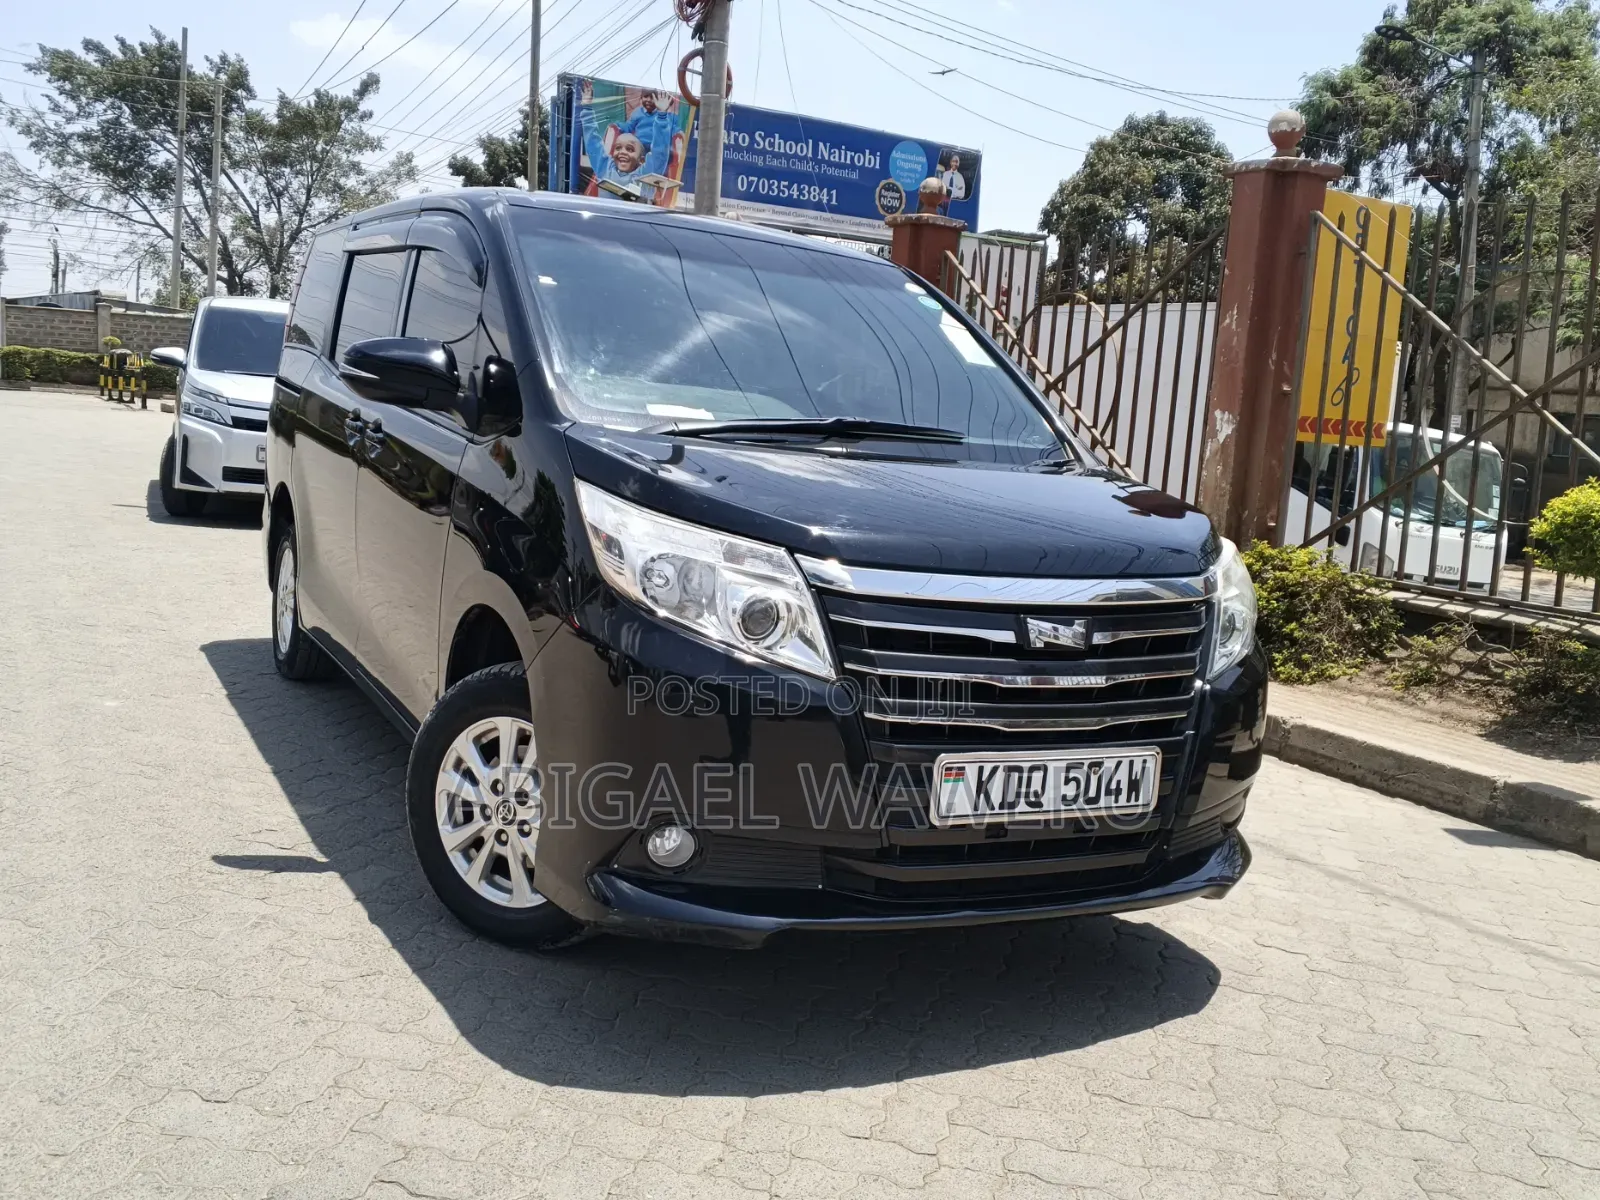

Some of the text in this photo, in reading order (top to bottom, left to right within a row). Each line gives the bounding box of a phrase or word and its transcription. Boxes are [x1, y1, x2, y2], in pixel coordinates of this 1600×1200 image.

[724, 147, 859, 179] nlocking Each Child's Potential
[754, 131, 813, 158] School
[817, 140, 880, 169] Nairobi
[737, 174, 838, 205] 0703543841
[880, 188, 901, 199] Register
[880, 196, 900, 208] NOW
[771, 208, 791, 218] Beyond
[973, 758, 1148, 812] KDQ 504W
